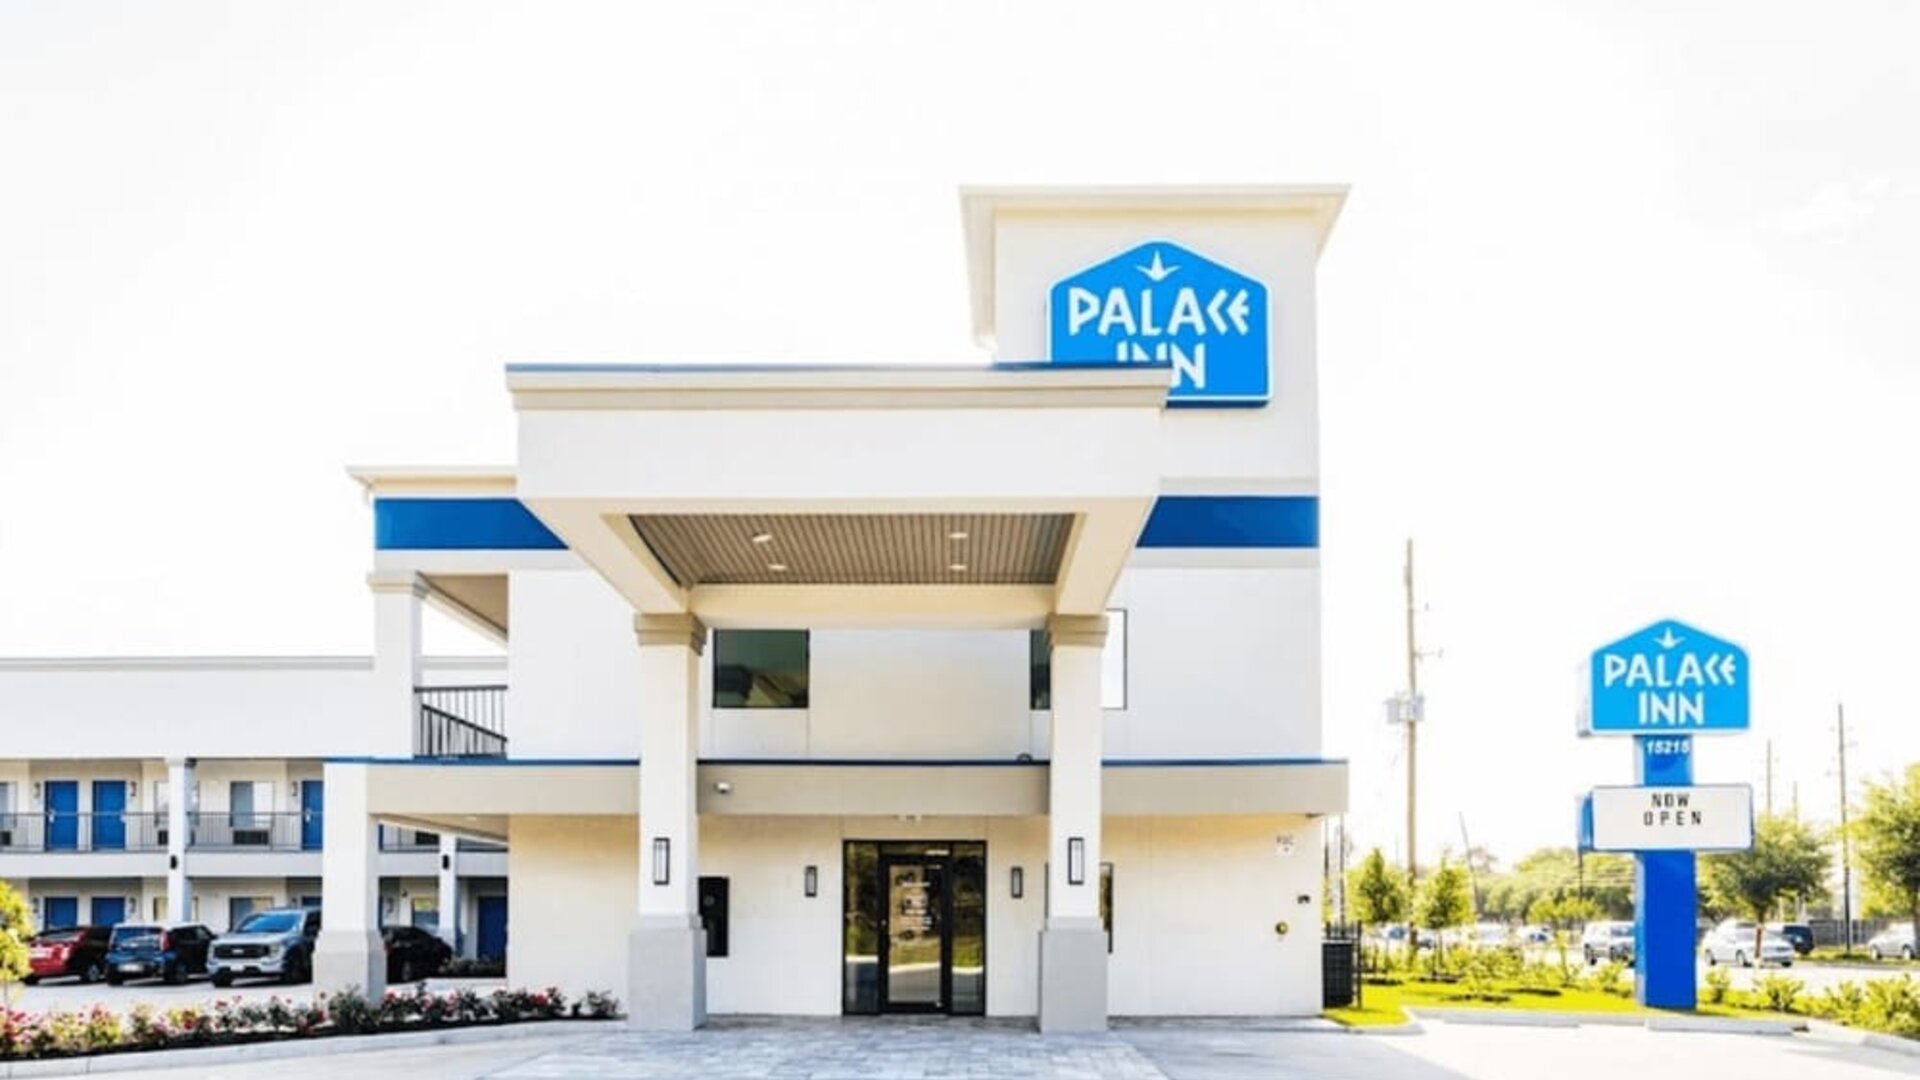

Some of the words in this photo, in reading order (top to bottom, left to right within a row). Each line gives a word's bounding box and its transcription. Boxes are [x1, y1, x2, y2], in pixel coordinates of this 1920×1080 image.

[1068, 287, 1249, 336] PALACE
[1603, 653, 1737, 688] PALACE
[1638, 691, 1704, 725] INN
[1651, 793, 1690, 808] NOW
[1643, 811, 1702, 826] OPEN
